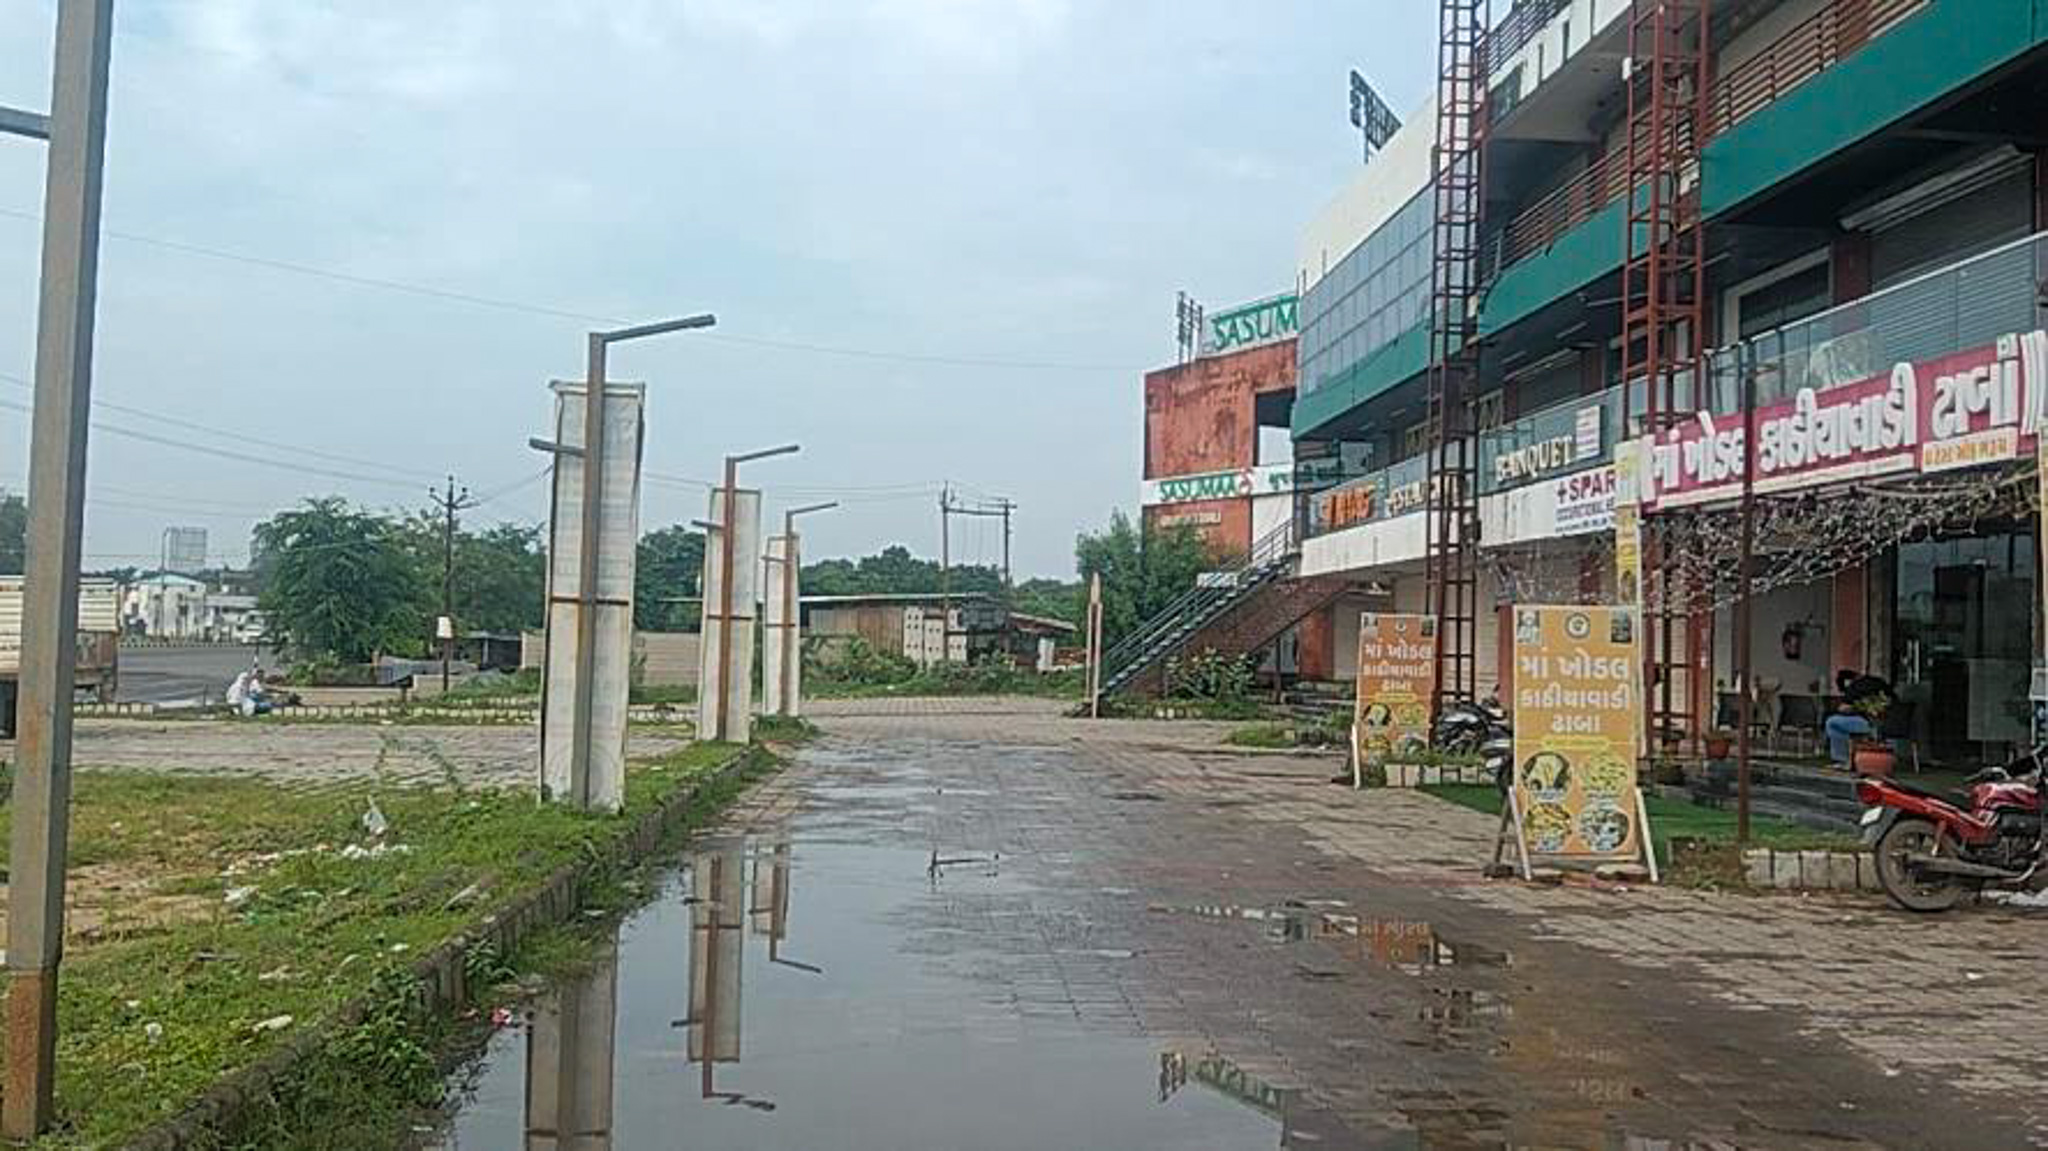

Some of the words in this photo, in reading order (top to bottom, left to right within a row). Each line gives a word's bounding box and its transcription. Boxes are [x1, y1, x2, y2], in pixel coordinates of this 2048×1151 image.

[1495, 436, 1572, 482] BANQUET
[1521, 646, 1549, 679] માં
[1557, 646, 1629, 680] ખોડલ
[1552, 714, 1601, 734] ઢાબા
